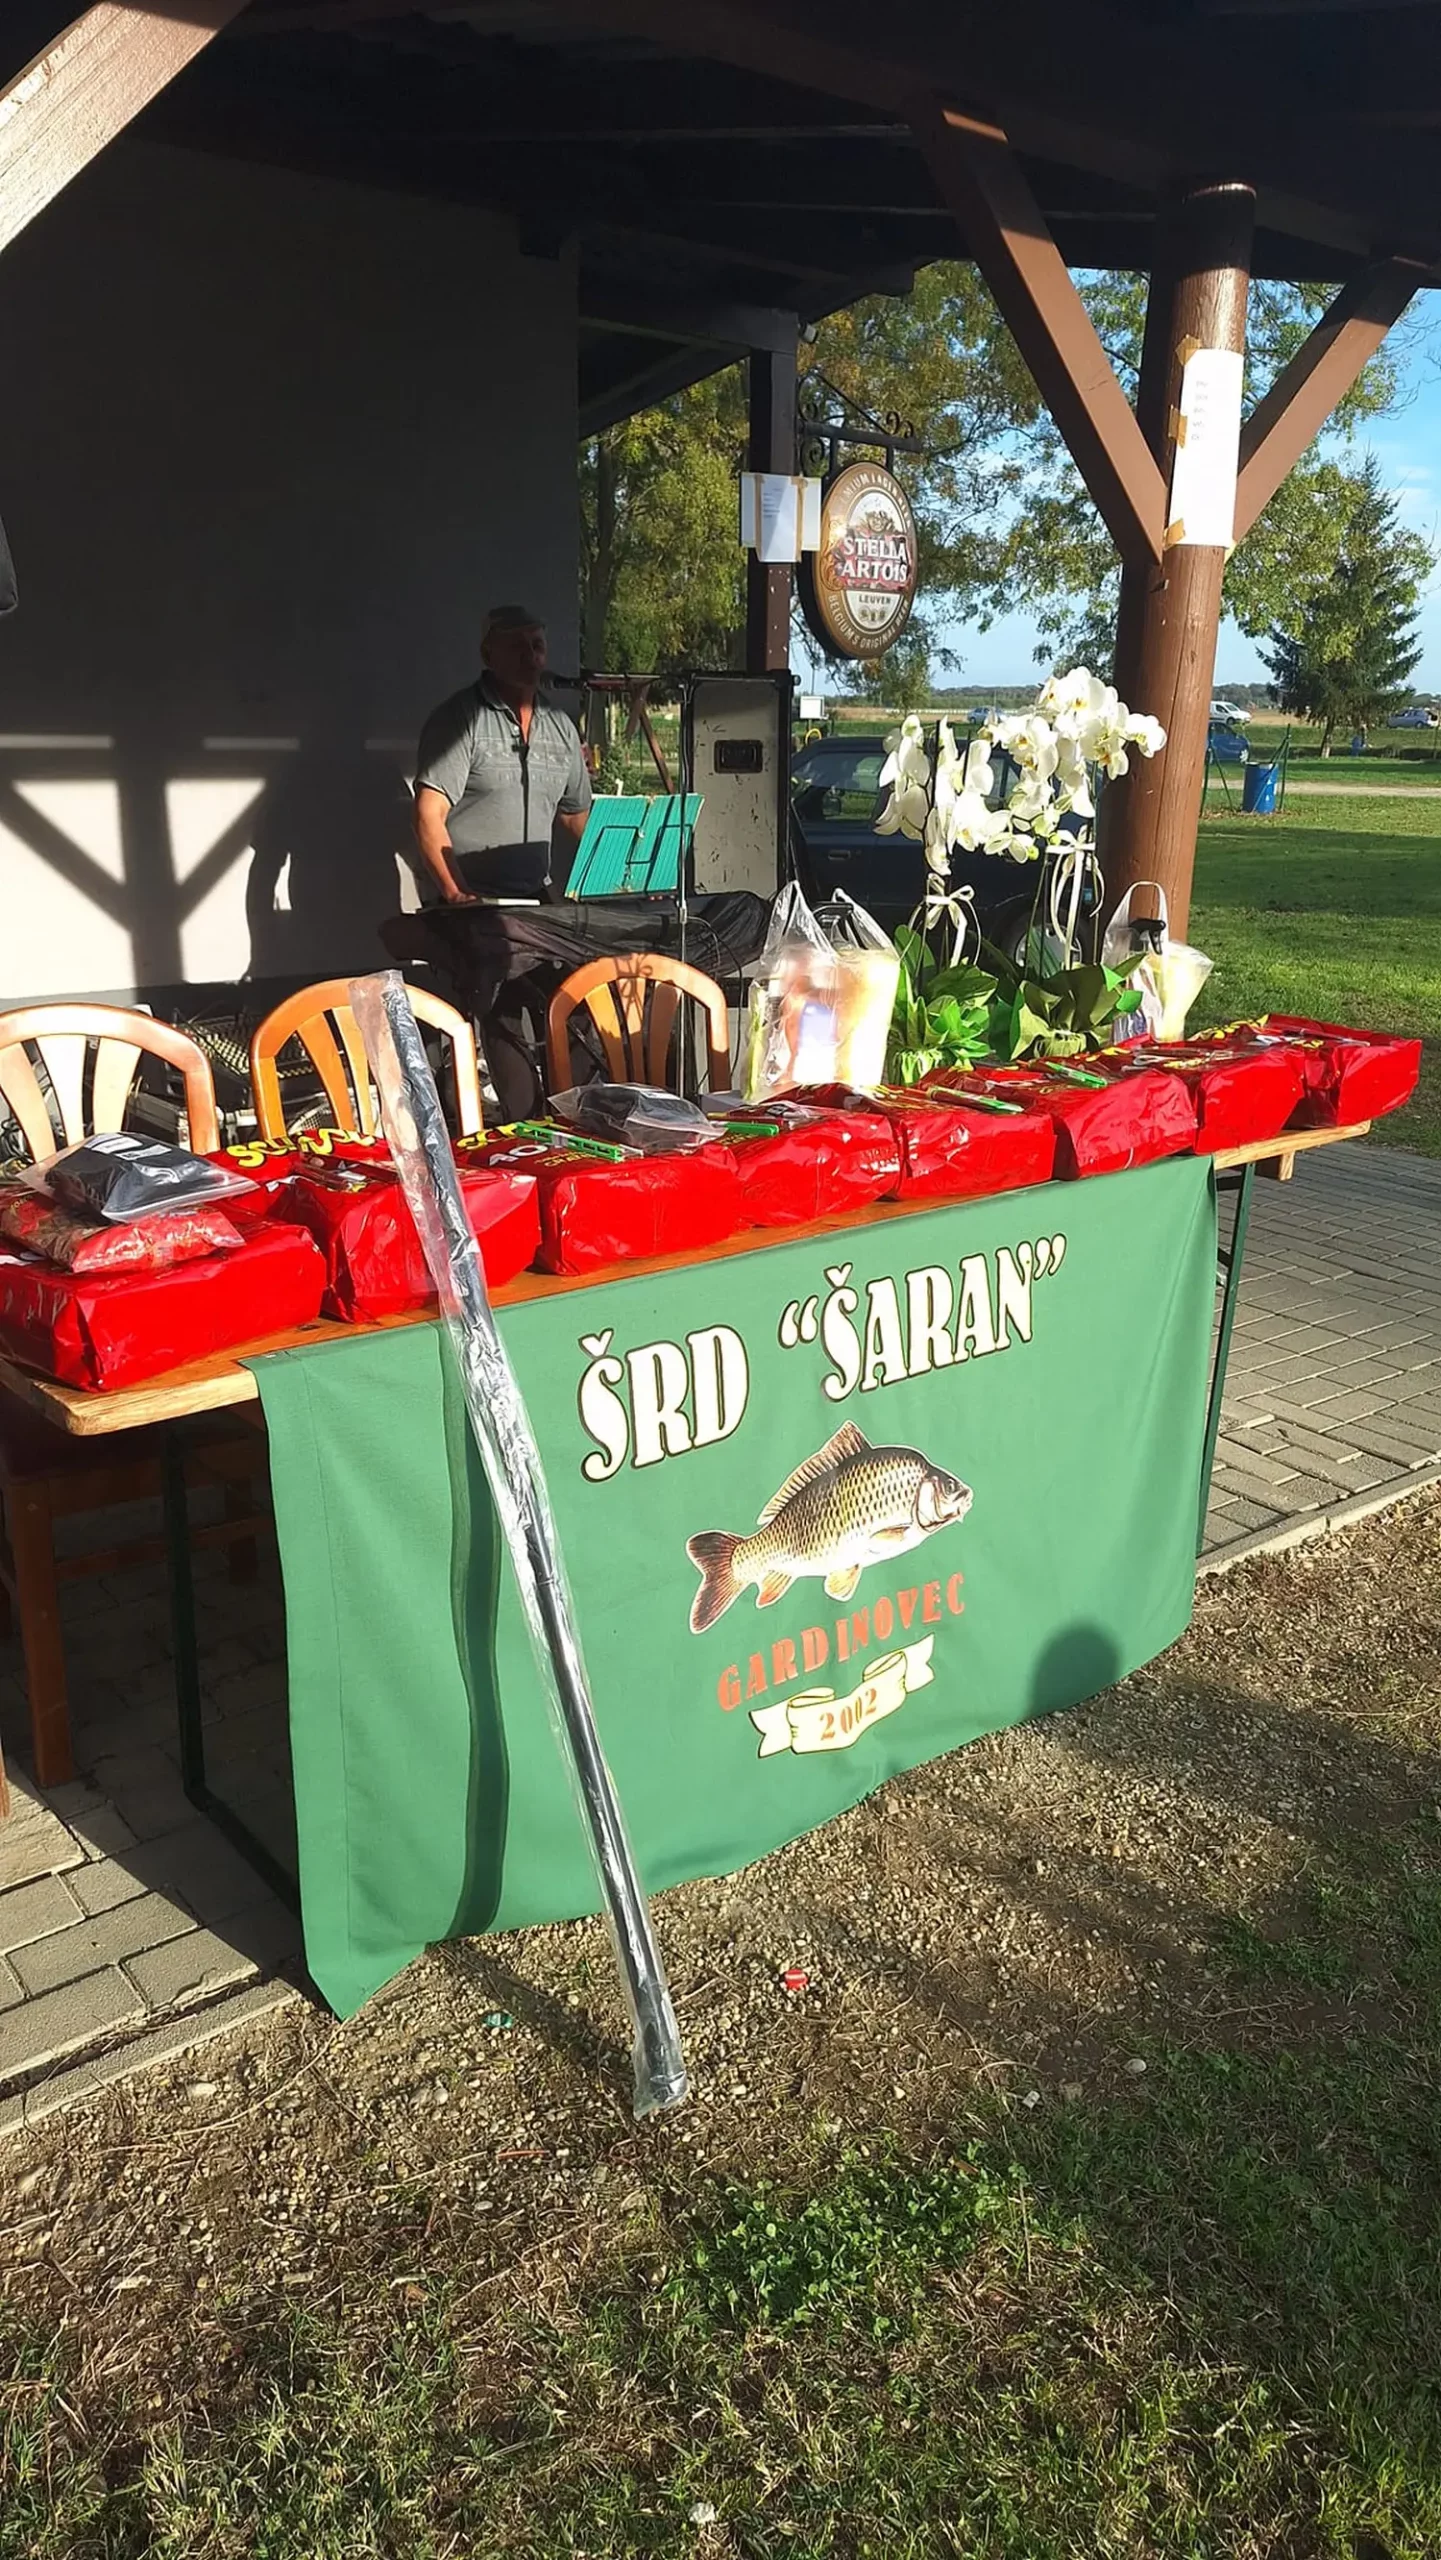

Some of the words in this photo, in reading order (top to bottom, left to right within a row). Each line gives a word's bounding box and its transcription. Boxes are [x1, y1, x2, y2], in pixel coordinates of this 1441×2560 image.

[840, 558, 908, 583] ARTOIS
[843, 536, 907, 561] STELLA
[577, 1324, 749, 1483] ŠRD
[717, 1572, 966, 1712] GARDINOVEC
[818, 1687, 878, 1742] 2002
